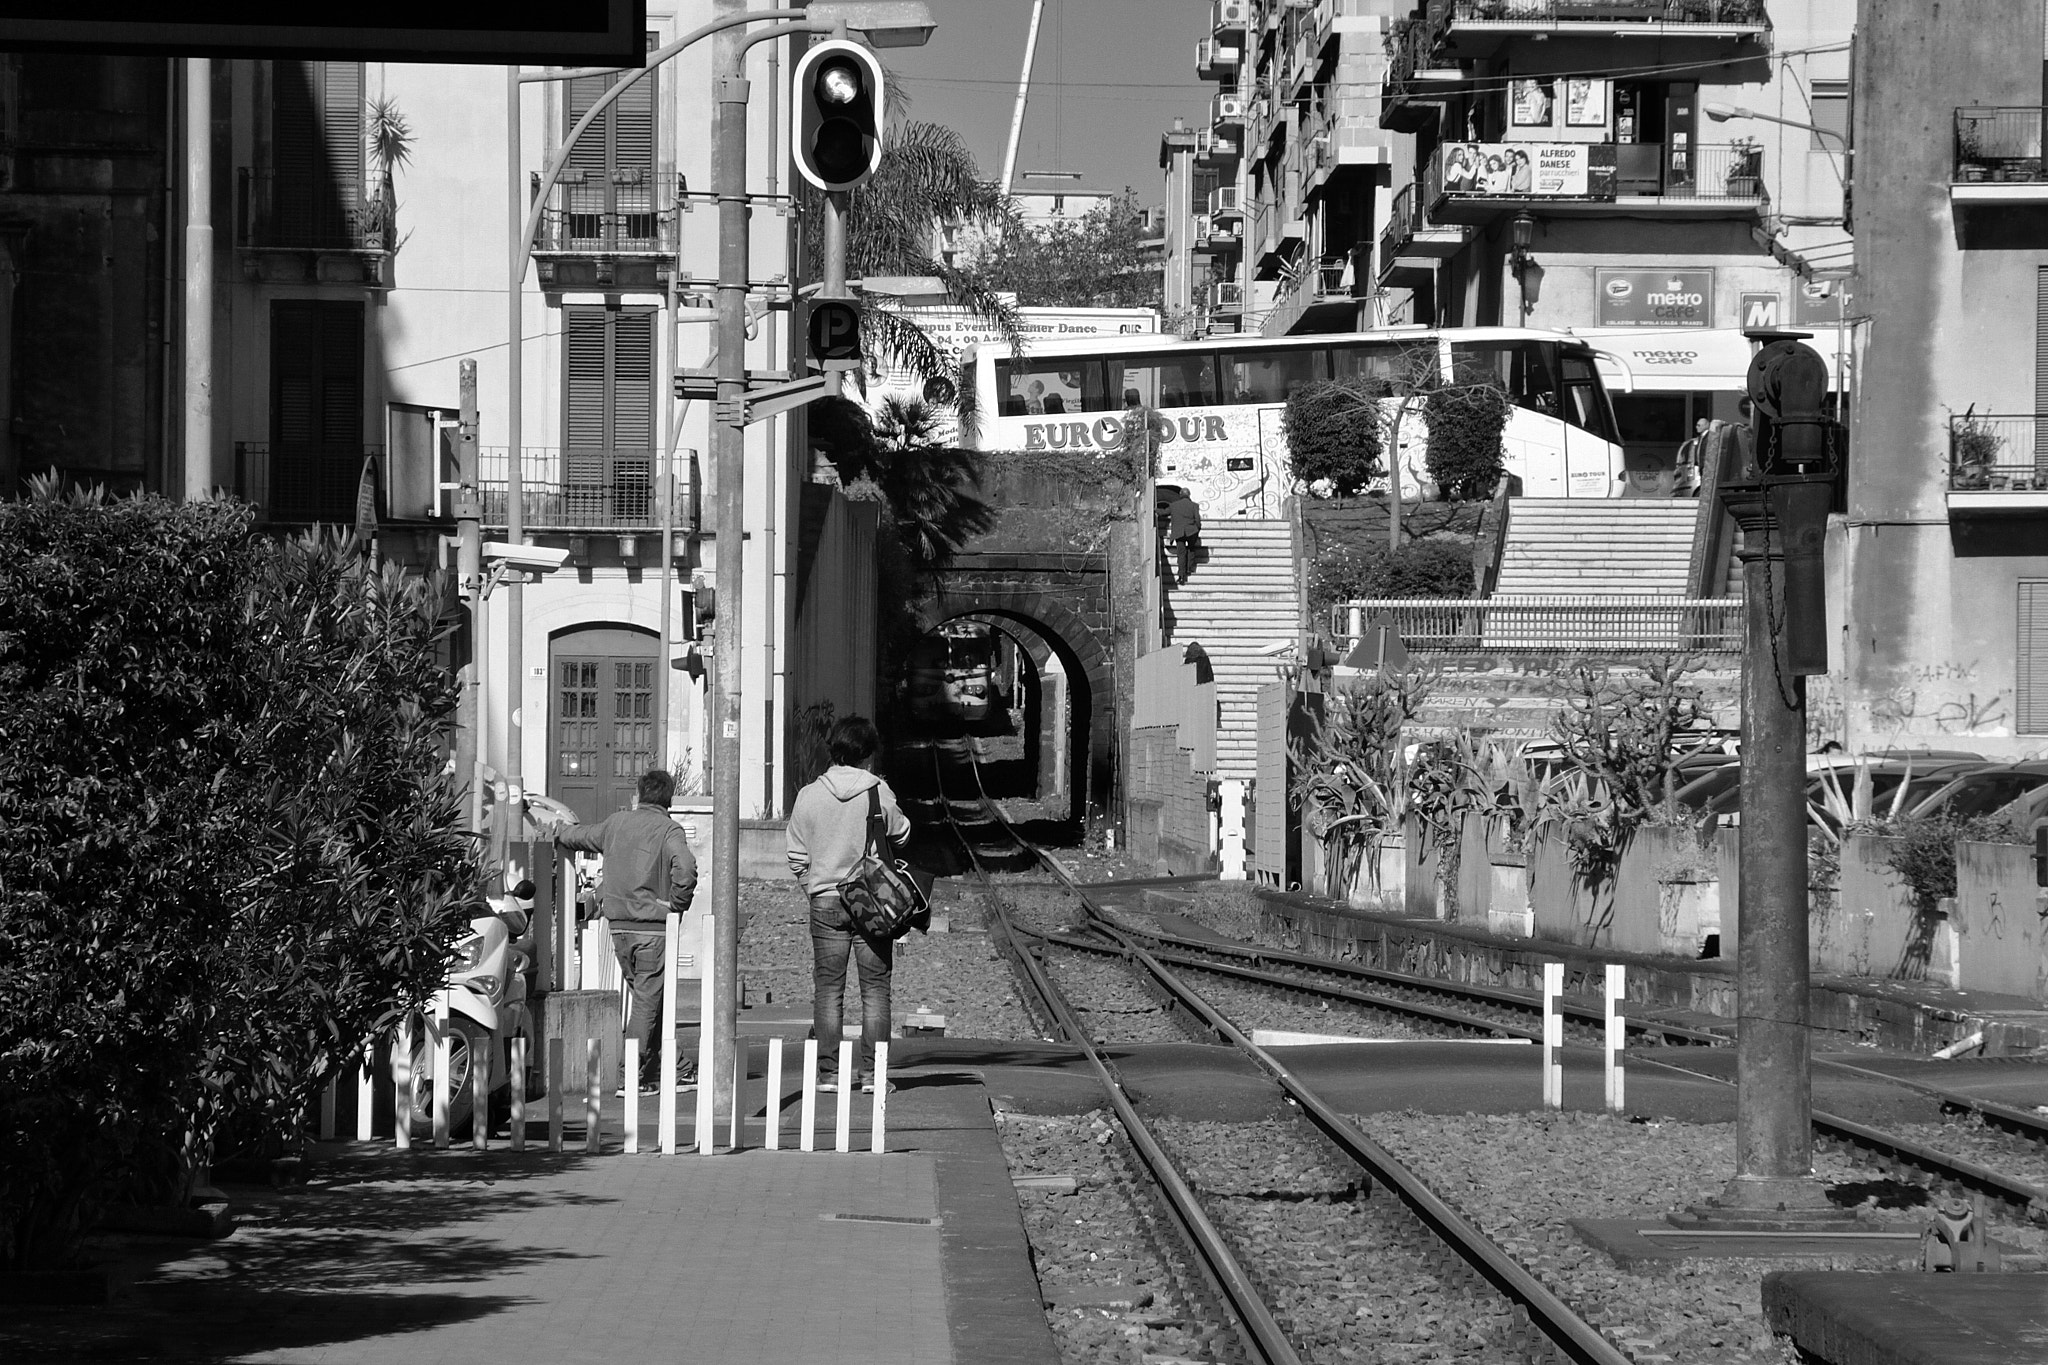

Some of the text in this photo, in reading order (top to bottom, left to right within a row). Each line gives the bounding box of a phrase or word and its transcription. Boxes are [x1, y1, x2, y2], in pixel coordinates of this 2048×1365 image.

[1540, 150, 1576, 158] ALFREDO
[1540, 160, 1571, 169] DANESE
[1539, 169, 1580, 177] parrucchieri
[1647, 293, 1703, 305] metro
[1746, 301, 1777, 327] M
[820, 310, 851, 347] P
[1058, 323, 1098, 334] Dance
[1632, 350, 1698, 358] metro
[1023, 415, 1229, 450] EURO OUR
